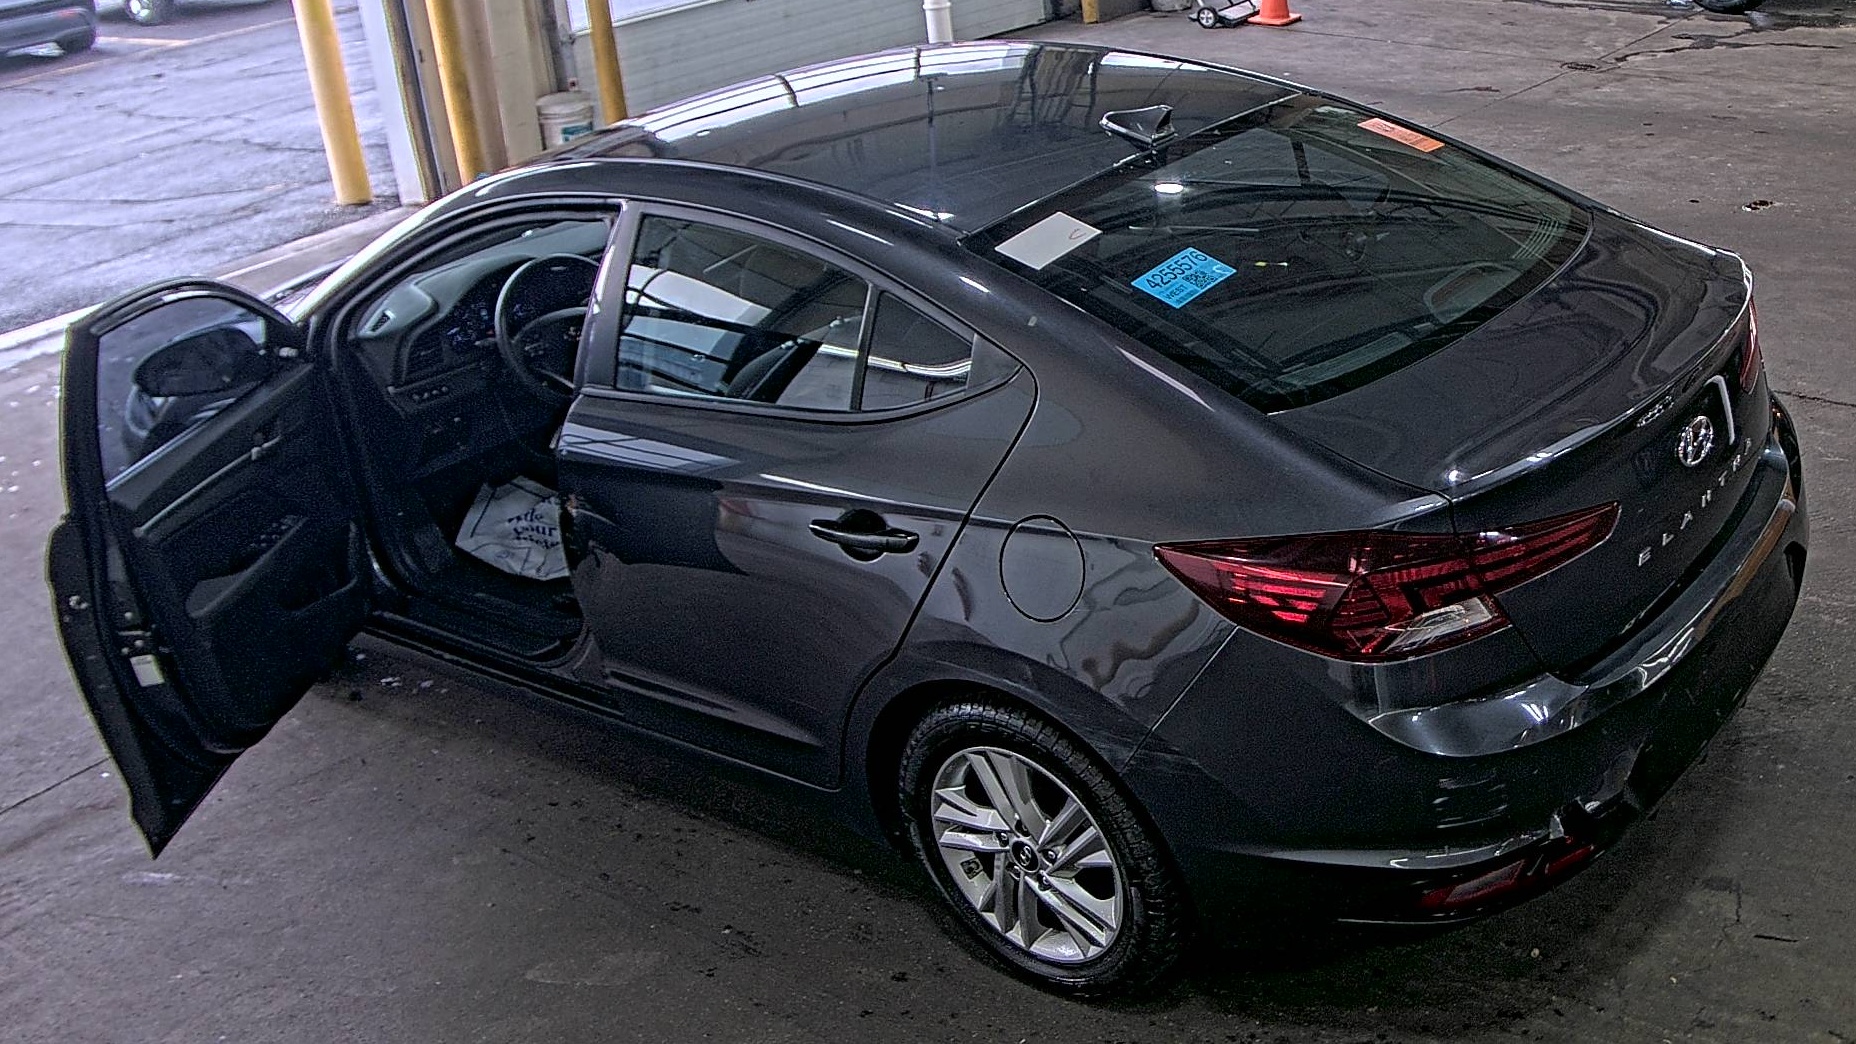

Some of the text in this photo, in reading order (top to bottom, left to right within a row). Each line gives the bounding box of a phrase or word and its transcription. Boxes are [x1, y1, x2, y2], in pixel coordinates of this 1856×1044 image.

[1146, 251, 1208, 289] 4255576
[1165, 284, 1188, 300] WEST
[1638, 437, 1752, 567] ELANTRA
